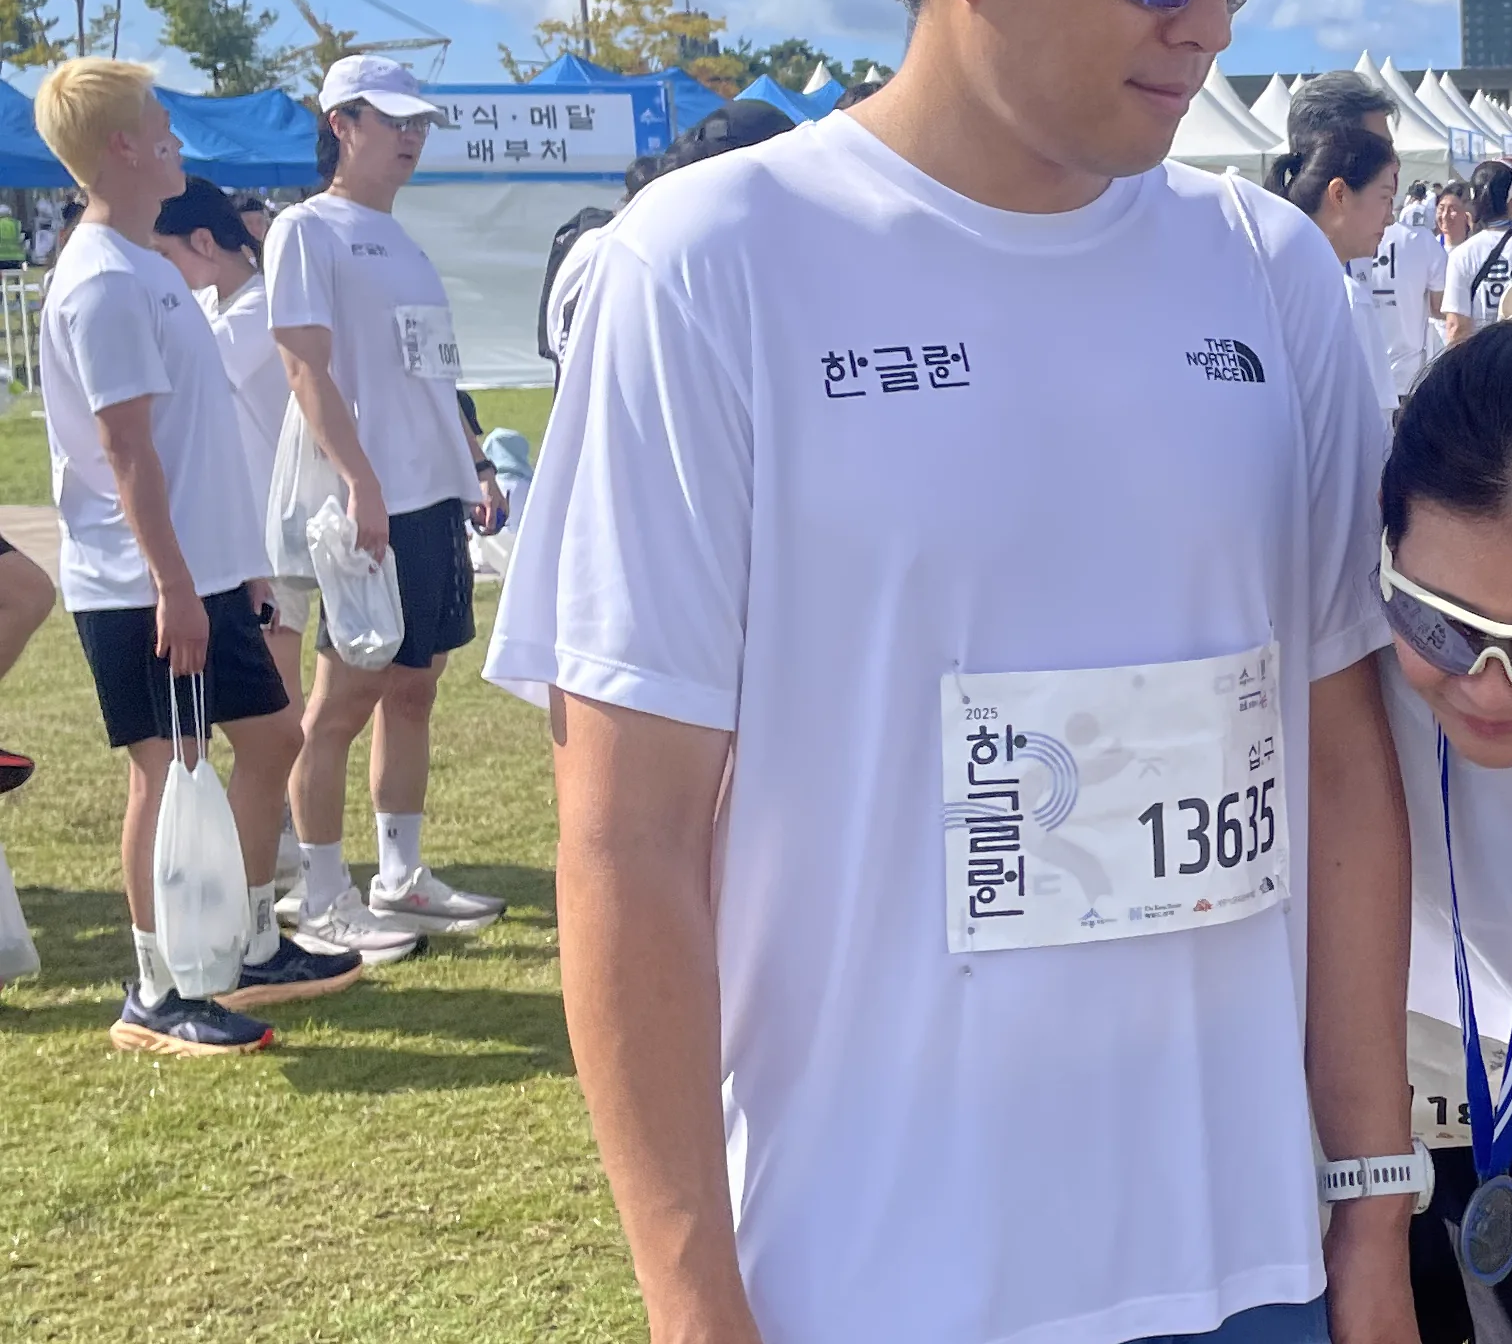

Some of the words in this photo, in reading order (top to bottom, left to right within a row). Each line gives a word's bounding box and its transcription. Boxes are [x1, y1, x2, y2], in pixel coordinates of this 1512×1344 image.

[467, 138, 567, 163] 배부처
[1203, 338, 1234, 353] THE
[1185, 351, 1238, 367] NORTH
[820, 341, 970, 399] 한글런
[1205, 366, 1242, 382] FACE
[965, 706, 999, 720] 2025
[1137, 777, 1276, 879] 13635
